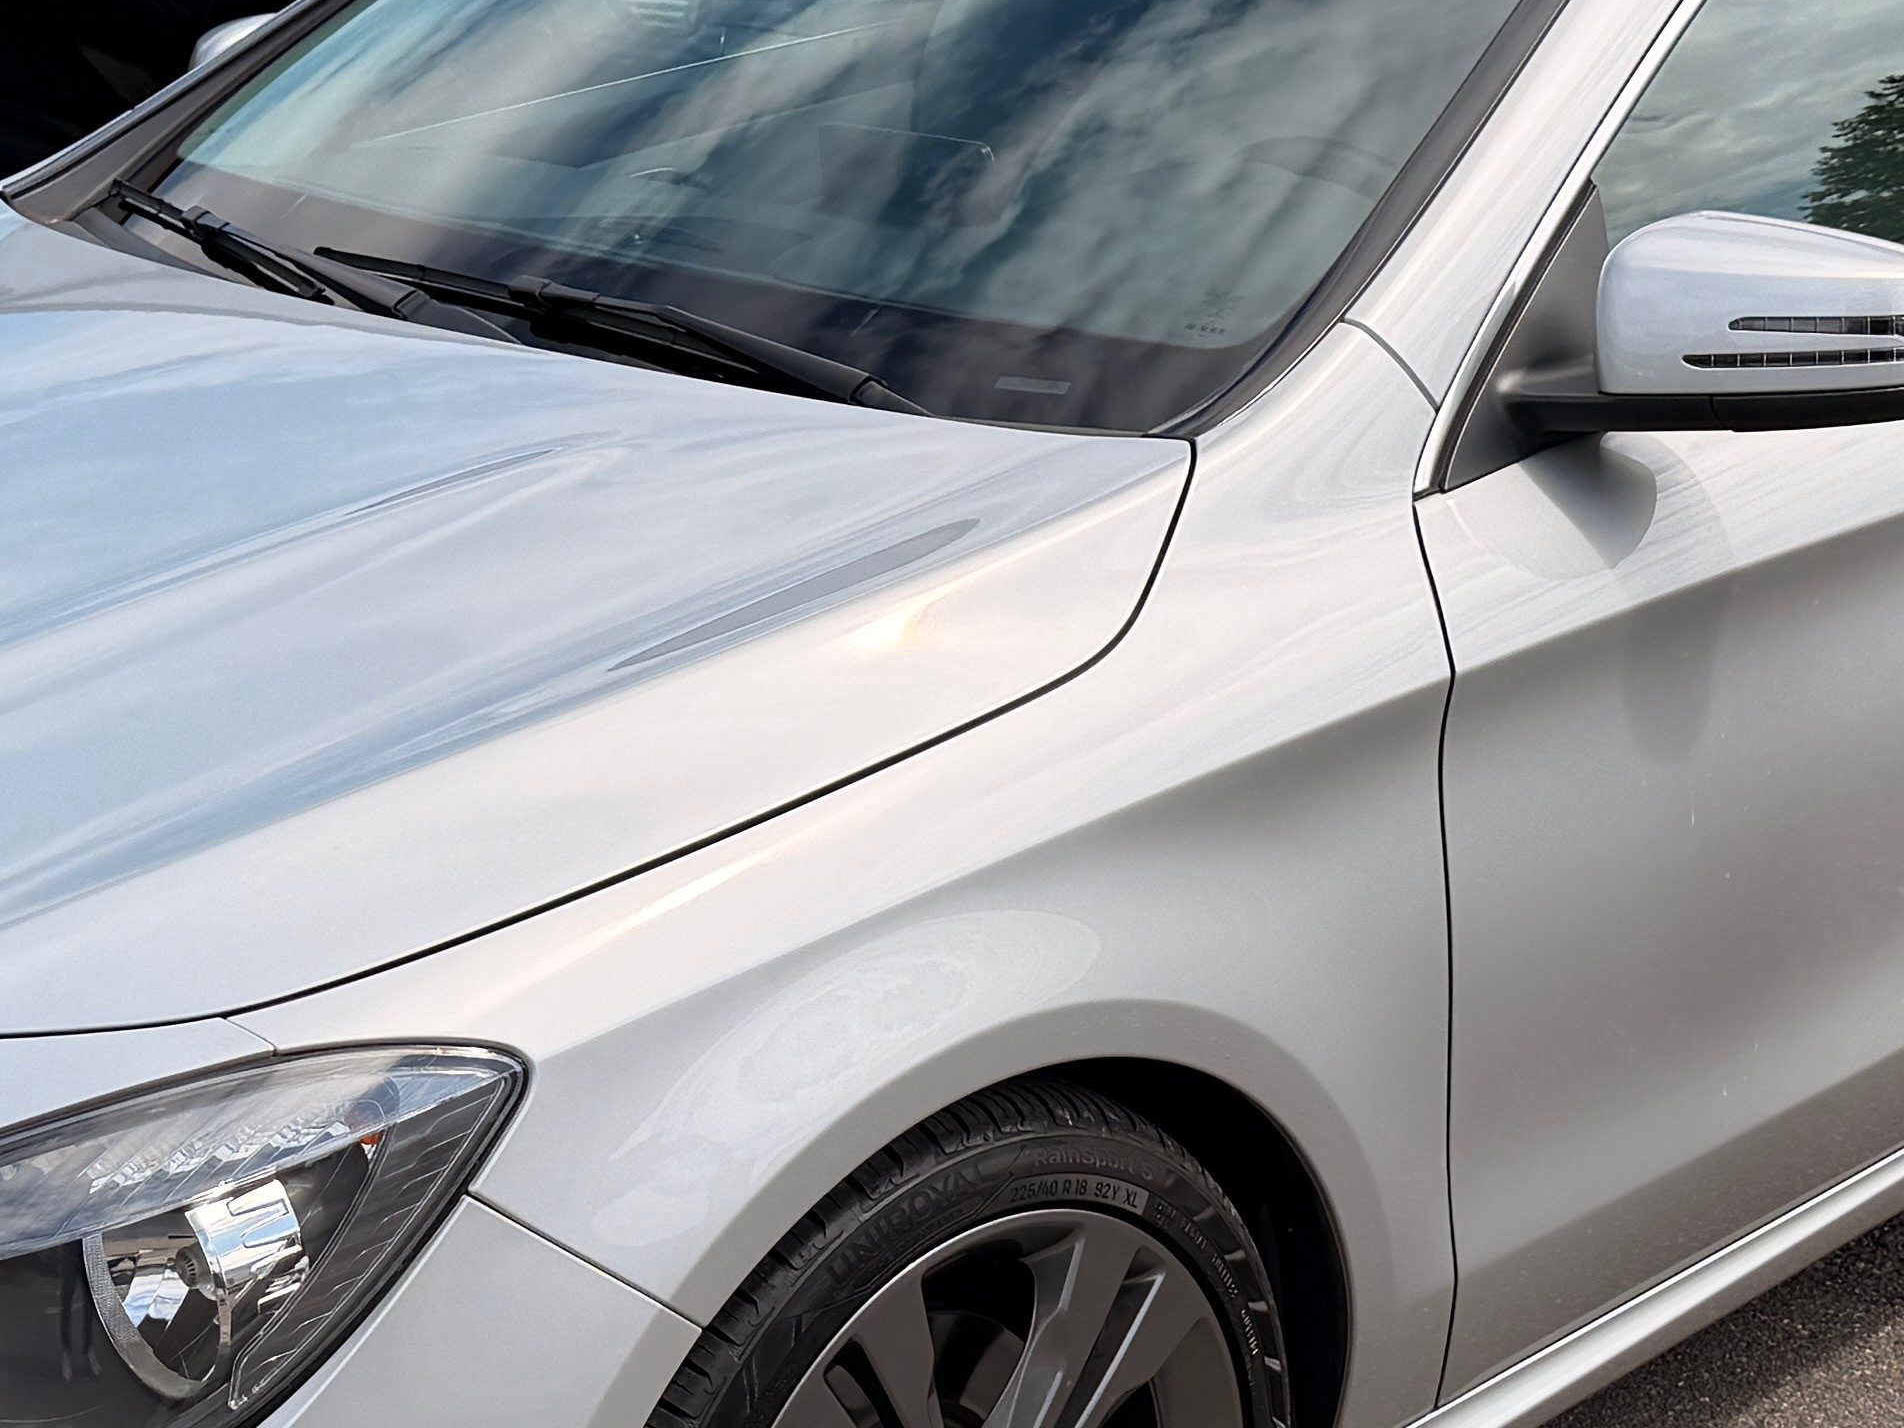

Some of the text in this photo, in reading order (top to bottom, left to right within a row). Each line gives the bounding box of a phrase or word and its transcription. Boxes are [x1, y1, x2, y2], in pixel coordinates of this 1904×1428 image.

[826, 1156, 990, 1284] UNIROYAL
[1074, 1179, 1087, 1196] 18
[1123, 1187, 1139, 1208] XL
